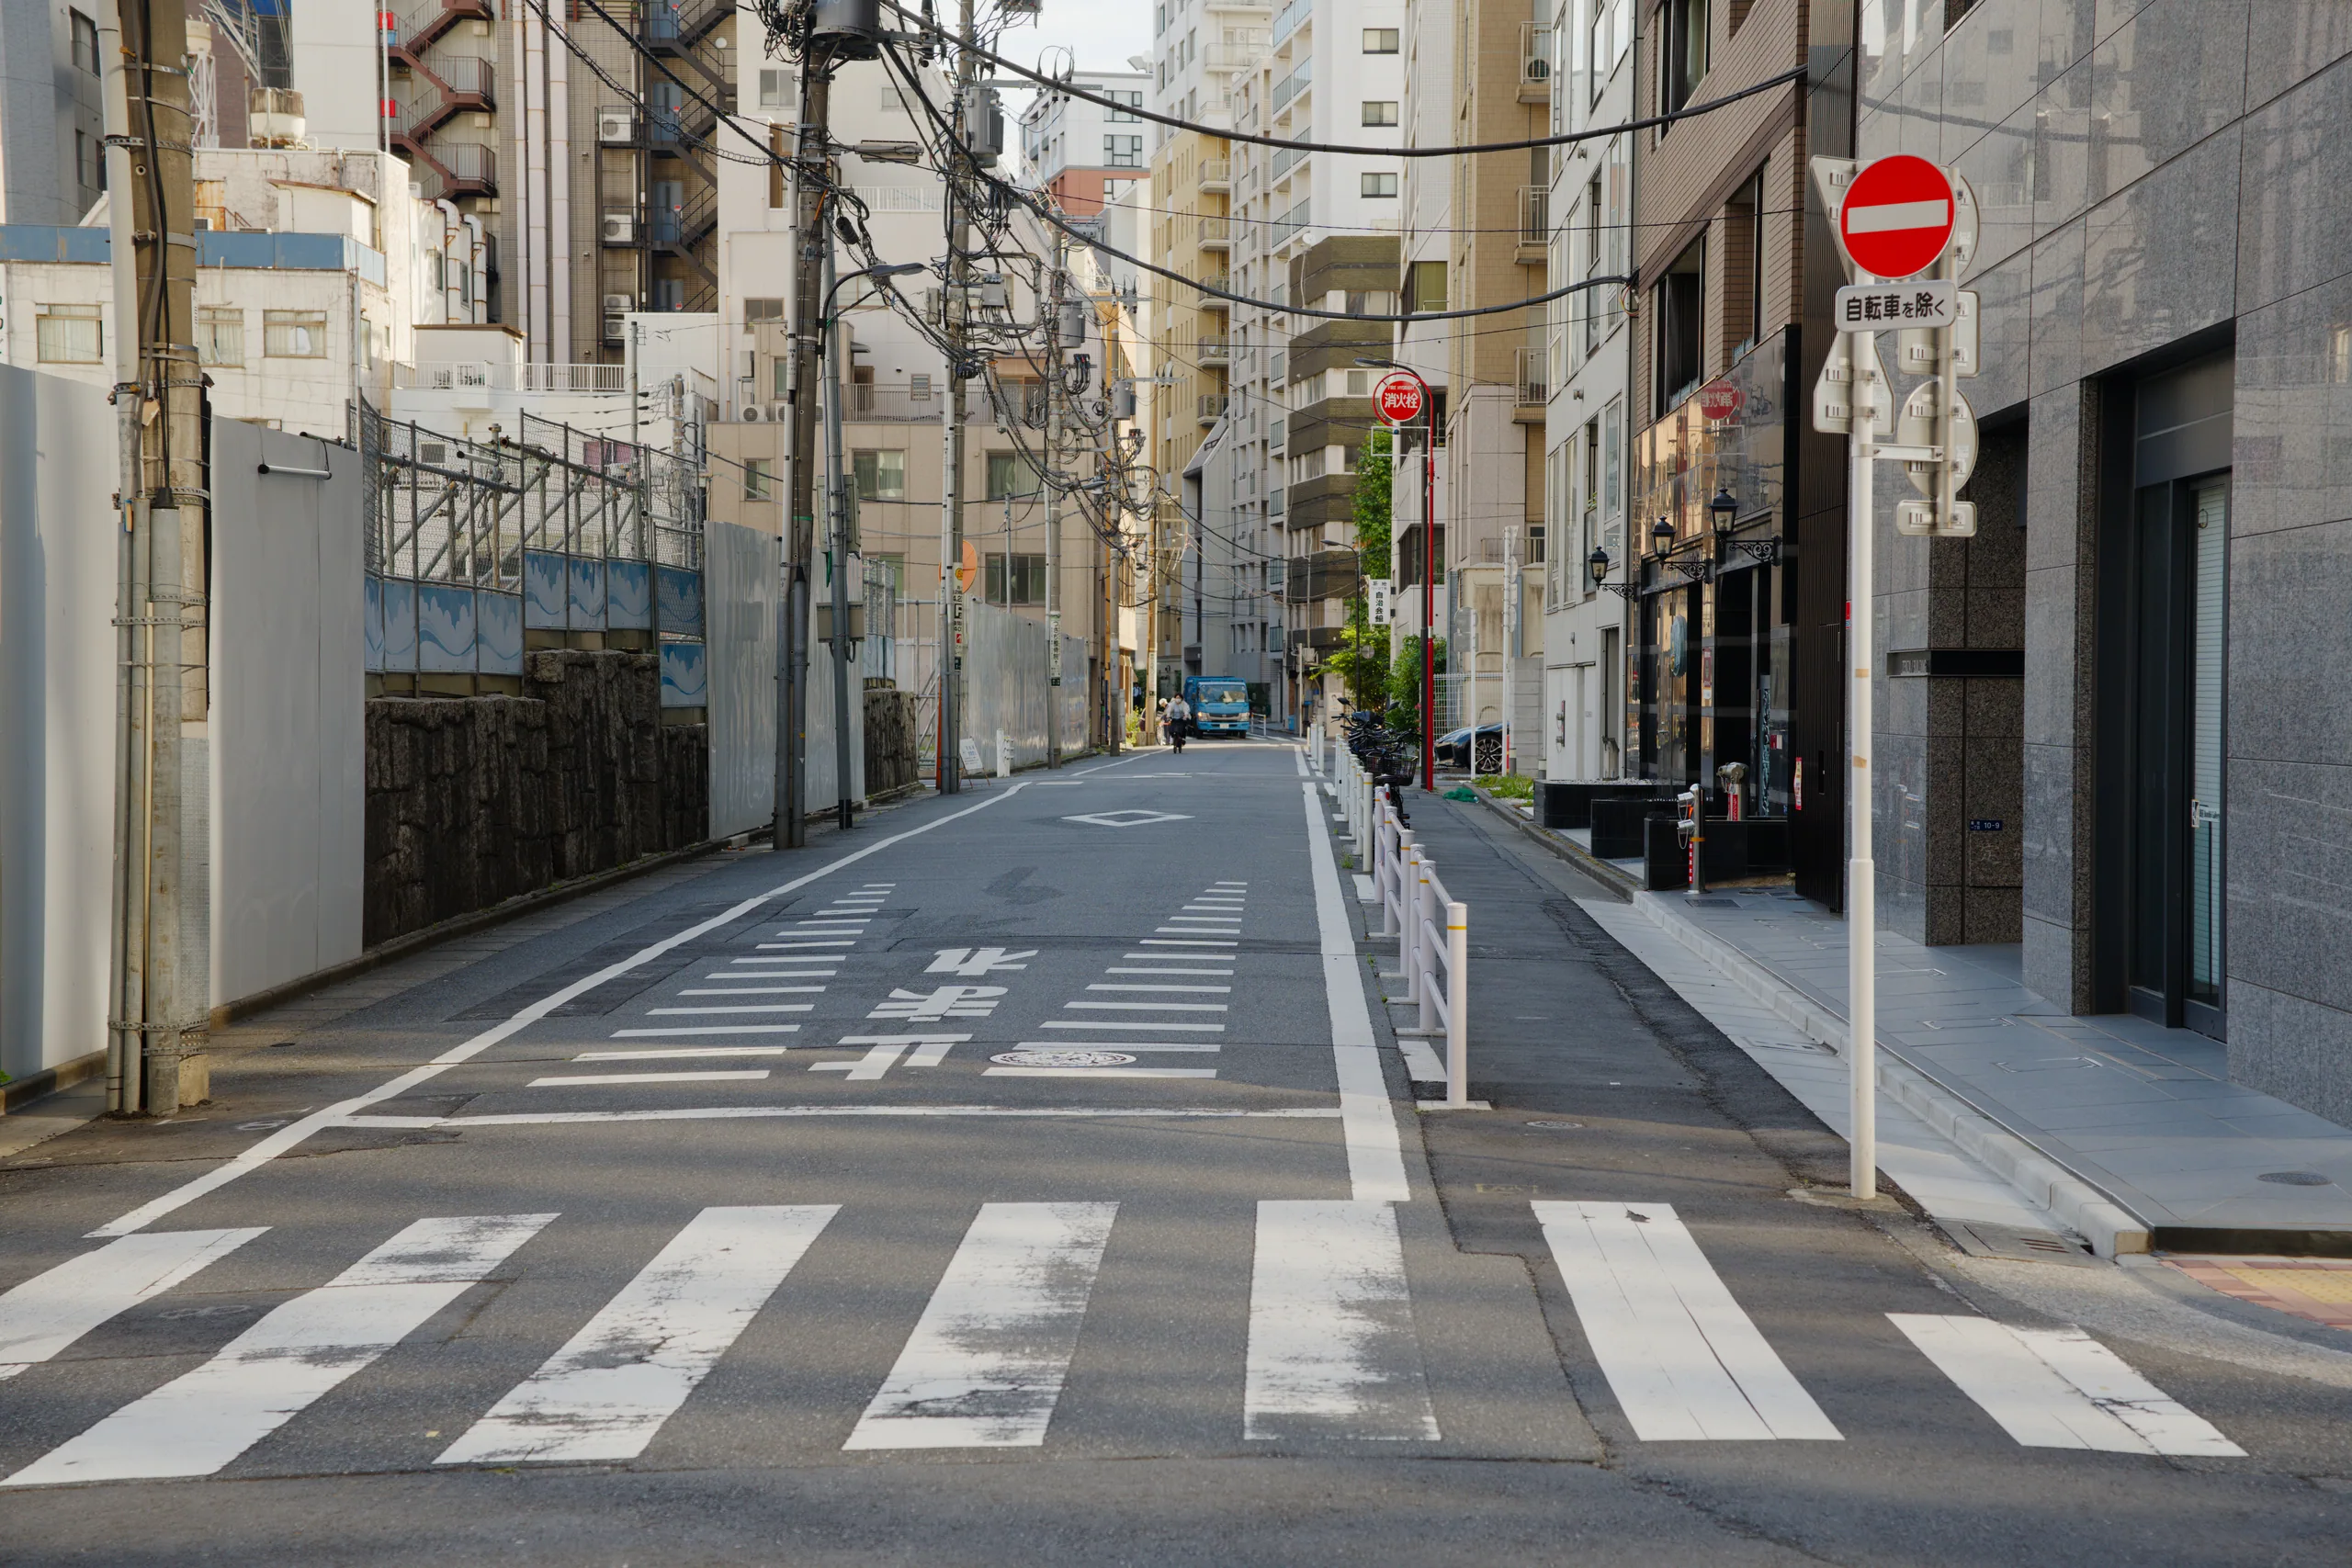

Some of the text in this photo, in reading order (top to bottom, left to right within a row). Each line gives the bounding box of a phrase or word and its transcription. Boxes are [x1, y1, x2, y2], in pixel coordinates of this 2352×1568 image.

[1846, 291, 1945, 321] 自転車を除く
[1385, 392, 1419, 408] 消火栓
[1375, 592, 1384, 622] 自治会館
[1984, 821, 2000, 829] 10-9
[808, 947, 1039, 1081] 止まれ
